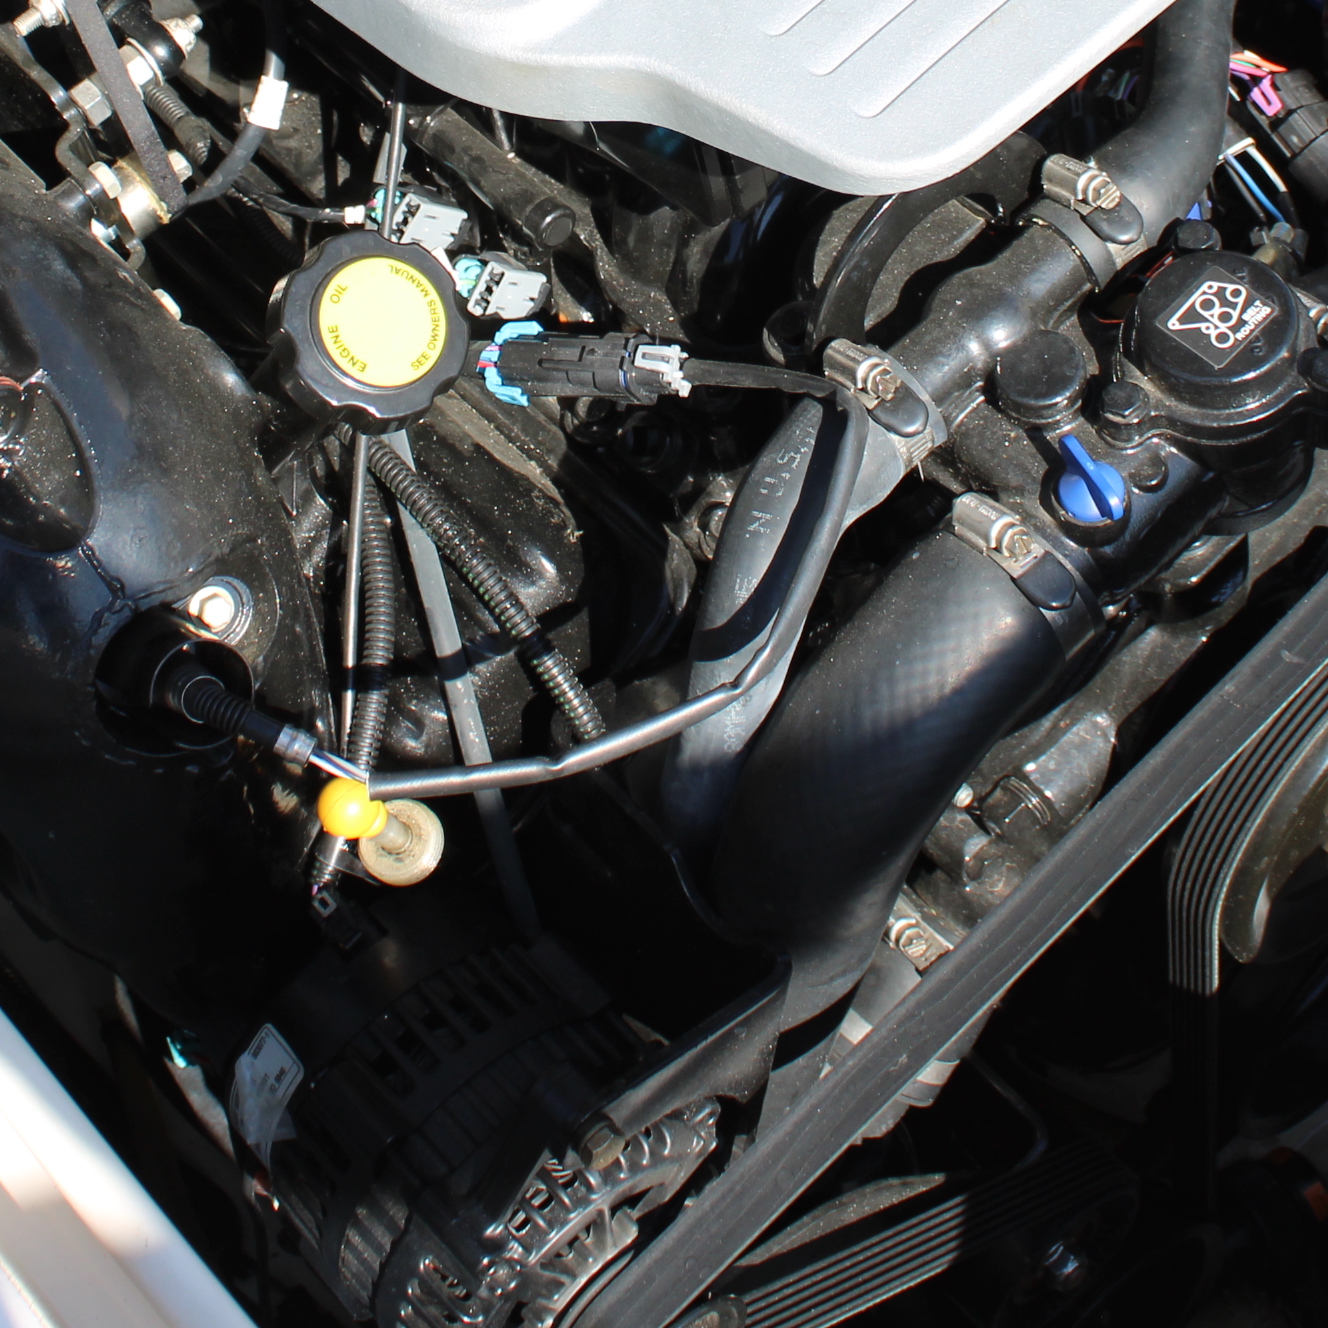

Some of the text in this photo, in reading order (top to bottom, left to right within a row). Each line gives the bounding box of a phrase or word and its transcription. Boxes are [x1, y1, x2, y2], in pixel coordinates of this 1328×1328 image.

[327, 283, 368, 373] ENGINE OIL
[386, 263, 440, 371] SEE OWNERS MANUAL
[1233, 303, 1273, 341] ROUTING
[1239, 299, 1264, 322] BELT
